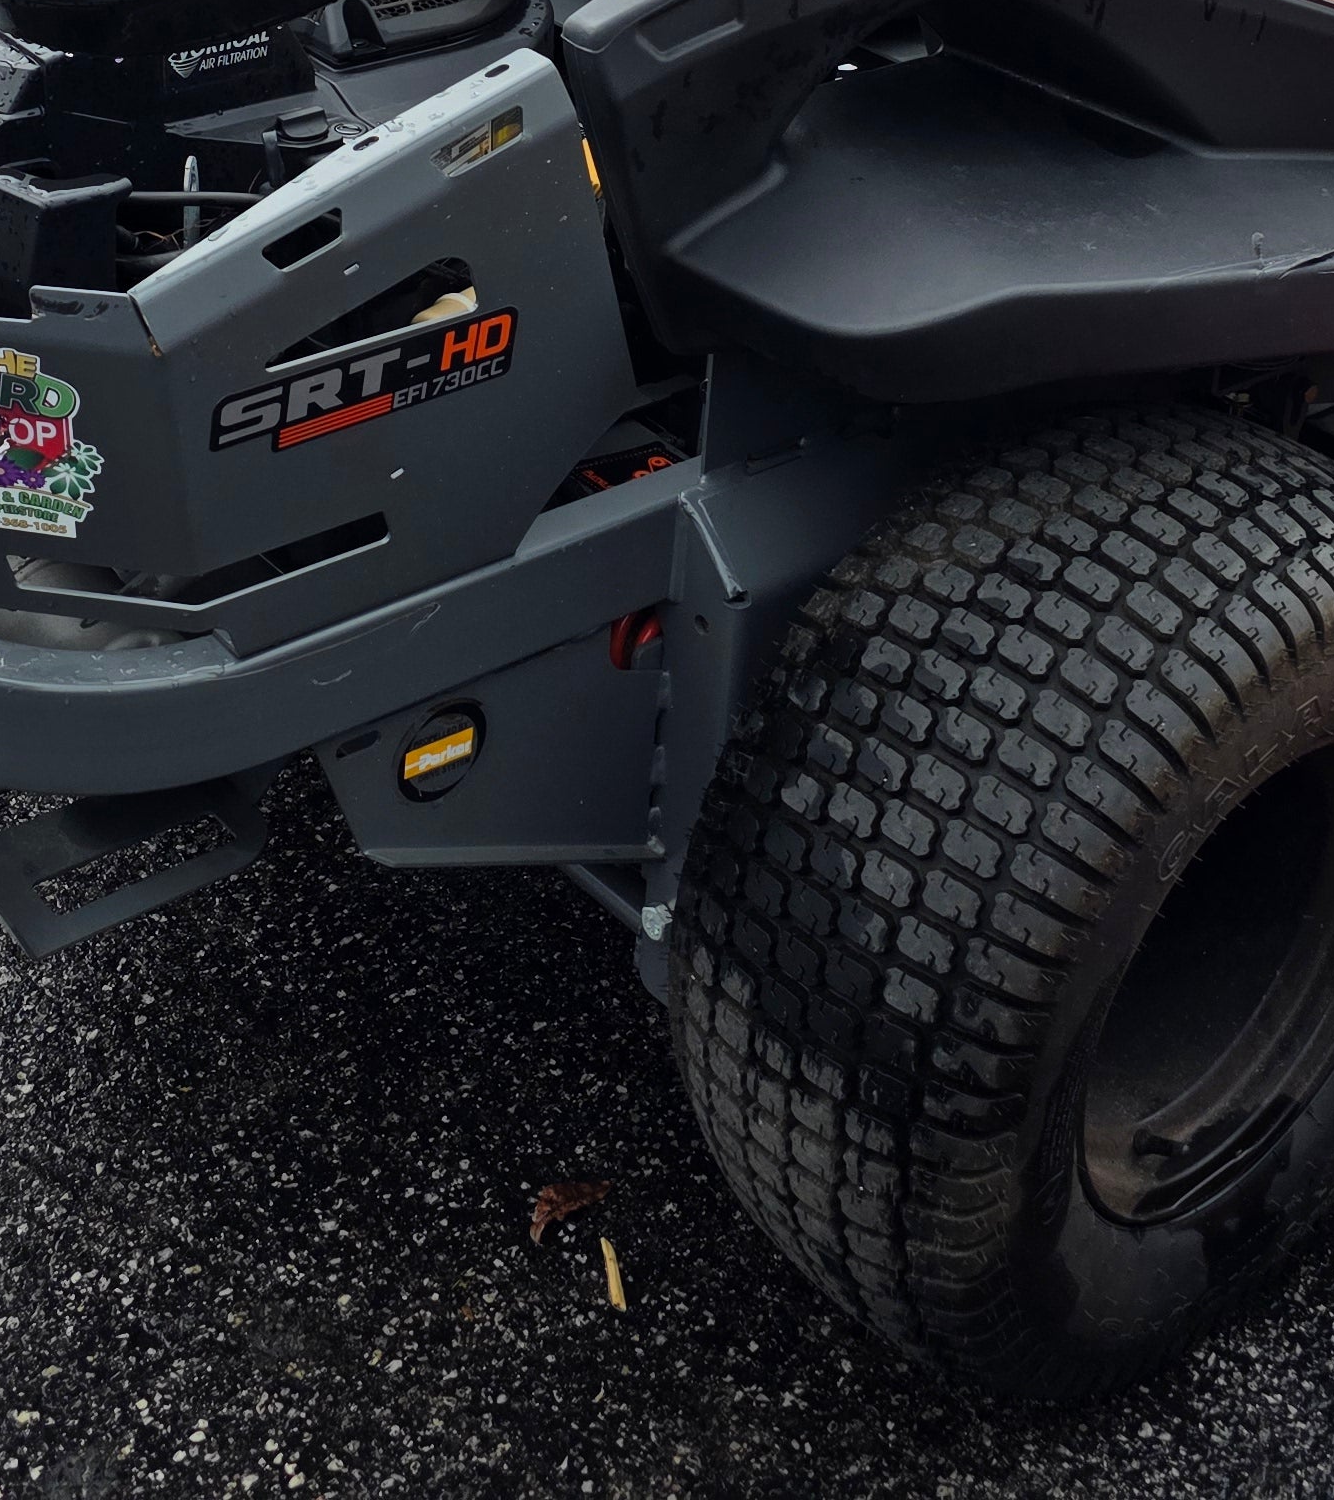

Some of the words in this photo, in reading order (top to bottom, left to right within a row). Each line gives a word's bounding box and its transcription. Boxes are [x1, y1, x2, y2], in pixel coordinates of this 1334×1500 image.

[199, 57, 216, 72] AIR
[217, 45, 269, 67] FILTRATION
[218, 314, 512, 445] SRT-HD
[393, 380, 427, 409] EFI
[432, 355, 505, 397] 730CC
[1, 490, 15, 503] &
[18, 490, 86, 520] GARDEN
[418, 740, 472, 771] Parker
